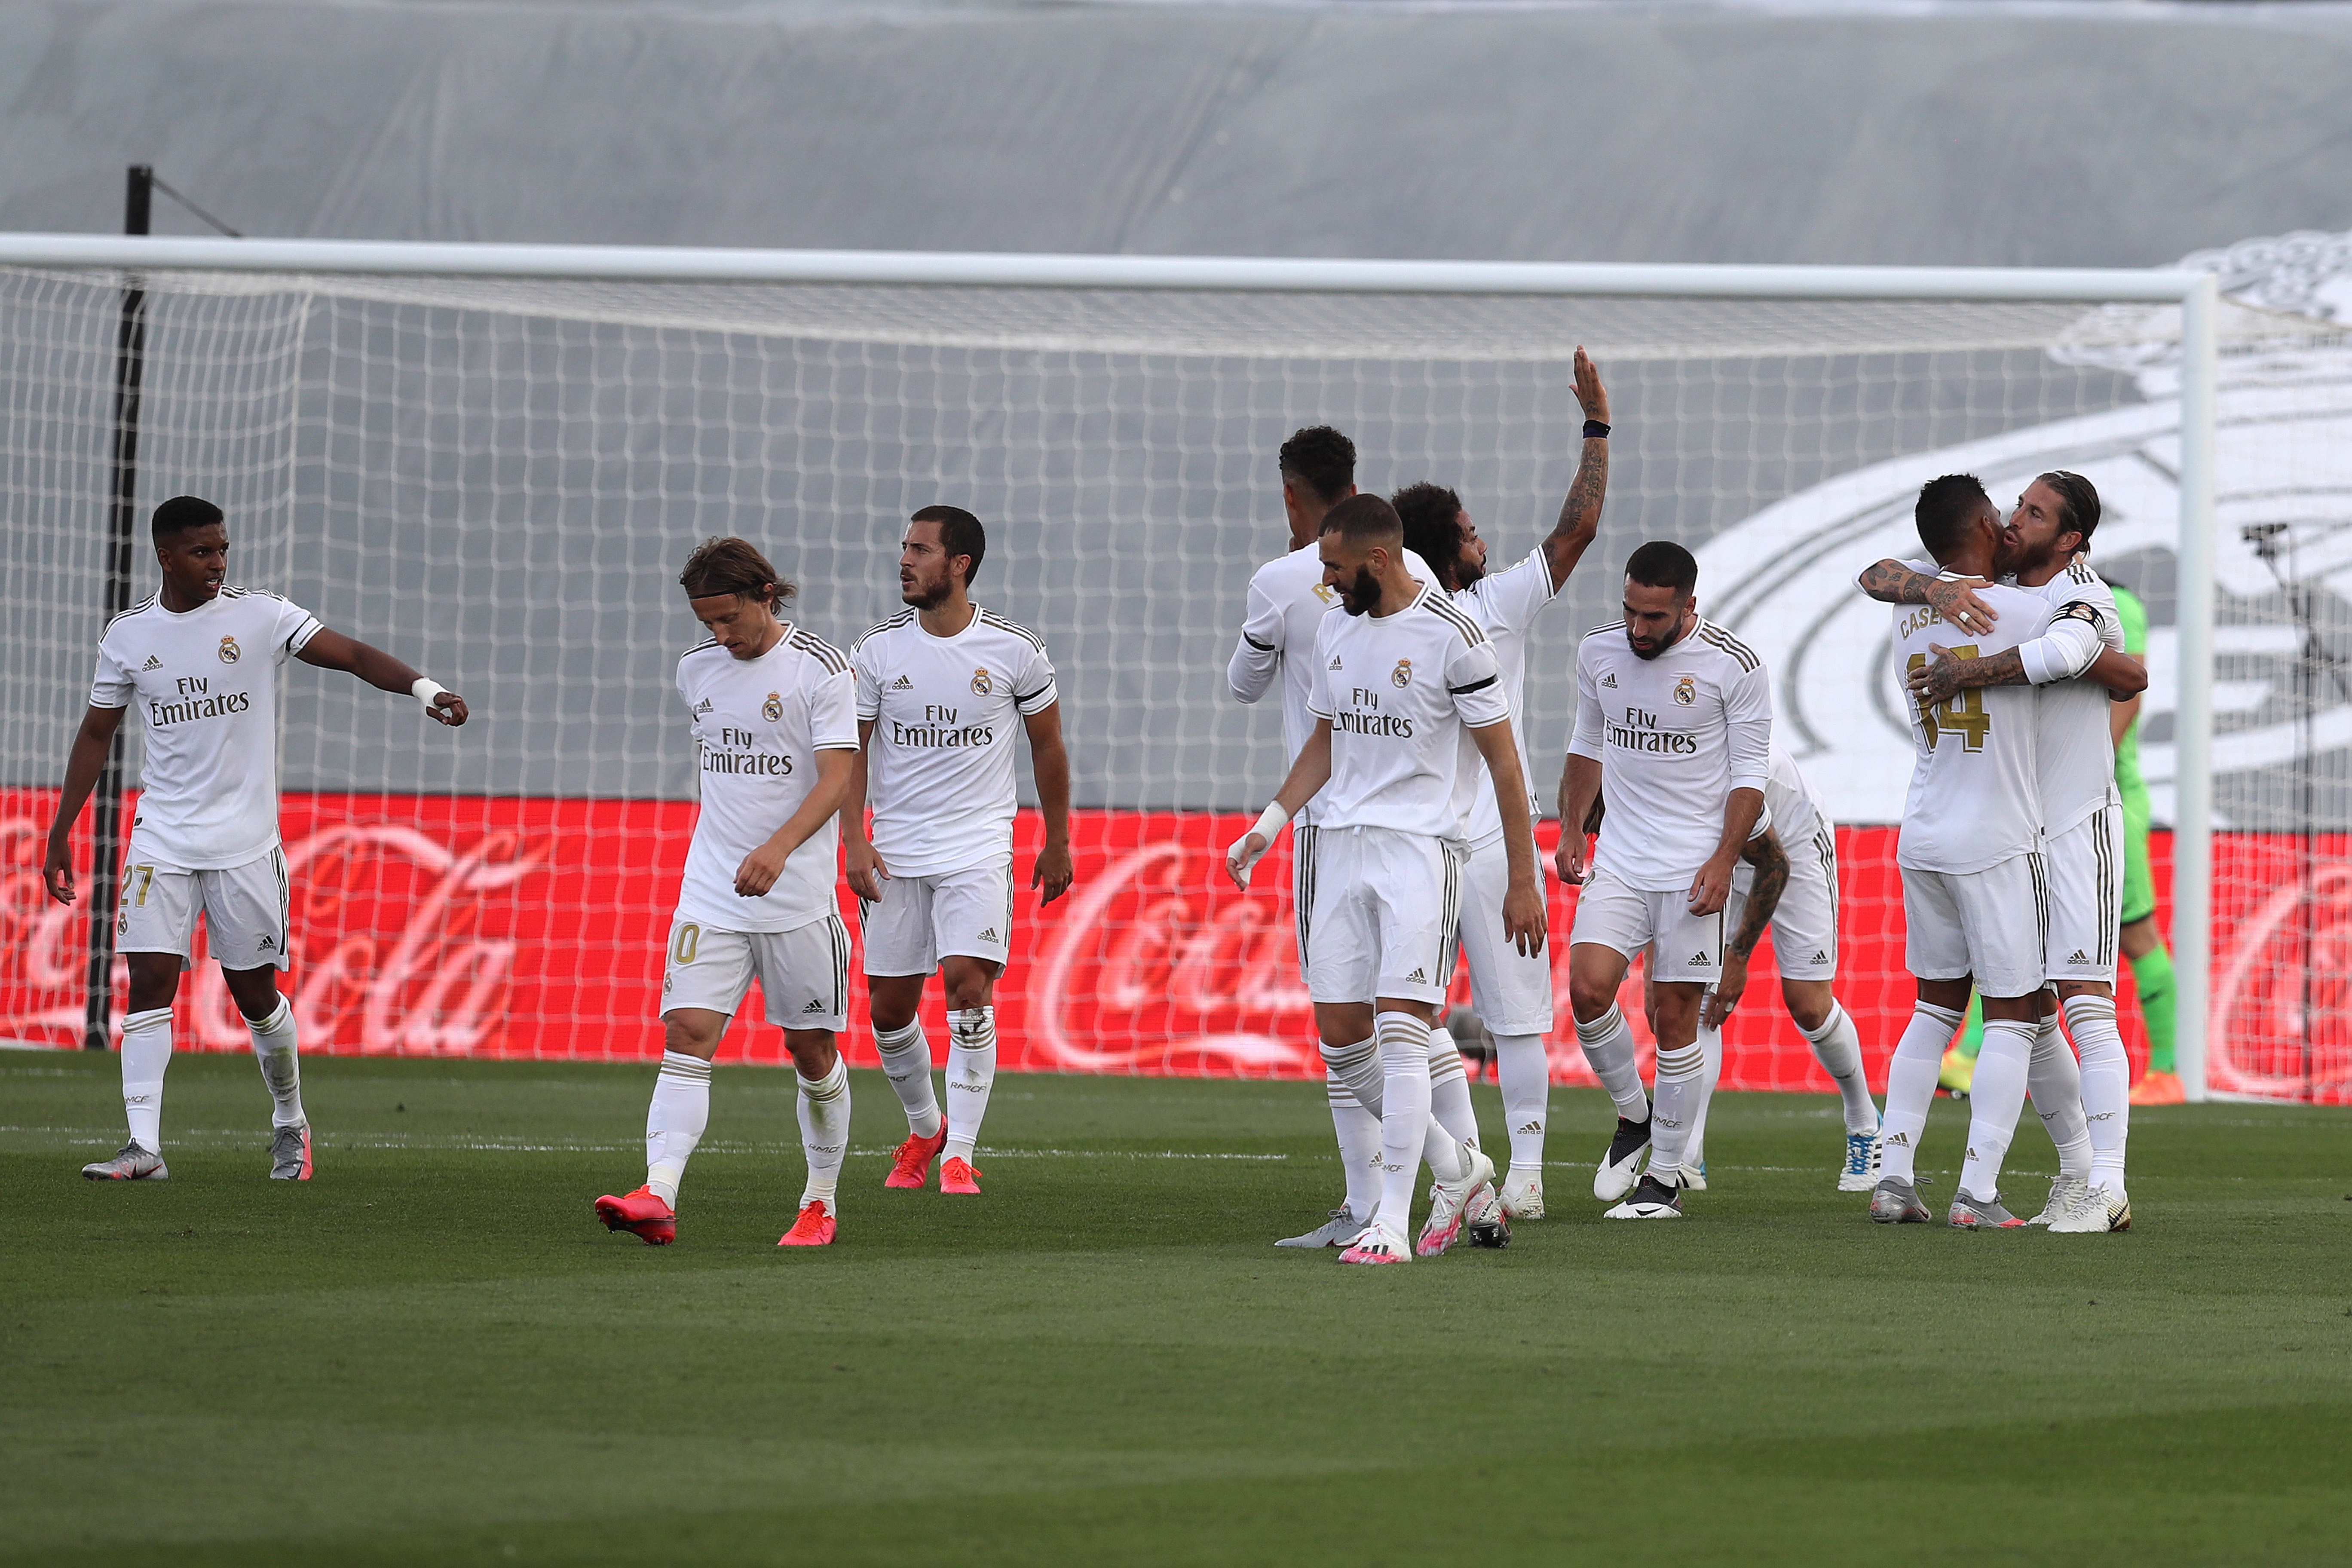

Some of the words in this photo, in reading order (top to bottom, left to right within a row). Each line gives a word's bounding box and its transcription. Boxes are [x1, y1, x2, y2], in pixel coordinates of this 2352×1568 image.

[1900, 606, 1942, 641] CASE
[142, 663, 163, 672] adidas
[177, 677, 207, 694] Fly
[150, 692, 249, 726] Emirates
[1353, 688, 1378, 710] Fly
[925, 705, 957, 724] Fly
[1333, 707, 1413, 738] Emirates
[1626, 707, 1656, 729] Fly
[722, 728, 752, 749] Fly
[894, 722, 993, 747] Emirates
[1607, 720, 1697, 753] Emirates
[703, 747, 793, 775] Emirates
[119, 864, 155, 908] 27
[668, 924, 700, 965] 0
[977, 934, 999, 943] adidas
[1406, 976, 1427, 984] adidas
[887, 1073, 912, 1082] MCF
[950, 1081, 986, 1093] RMCF
[1652, 1113, 1683, 1128] RMCF
[648, 1130, 665, 1139] CF
[1886, 1140, 1910, 1148] adidas
[808, 1142, 843, 1153] RMCF
